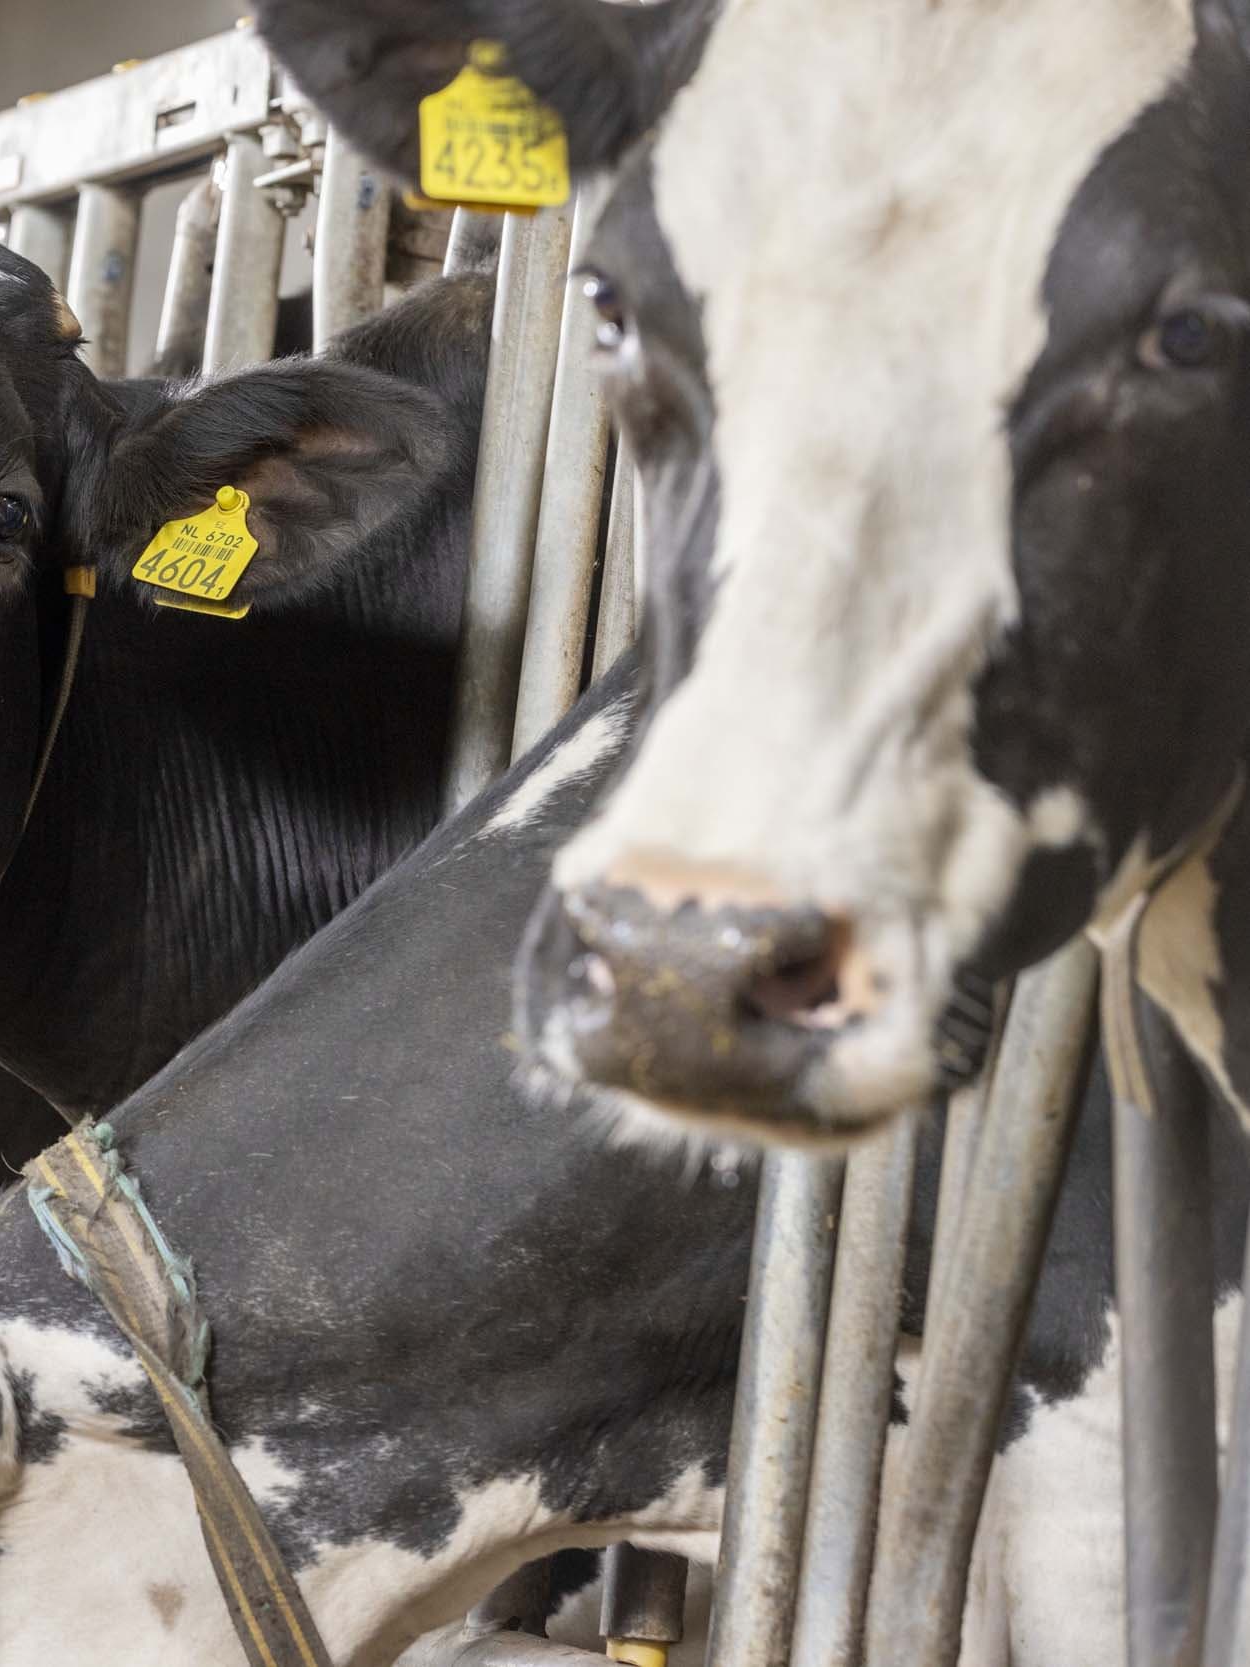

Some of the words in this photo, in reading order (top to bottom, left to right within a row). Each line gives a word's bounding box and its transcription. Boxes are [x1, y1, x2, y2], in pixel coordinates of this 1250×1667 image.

[433, 136, 547, 192] 4235
[180, 523, 199, 539] NL
[205, 531, 244, 549] 6702
[140, 548, 226, 595] 4604
